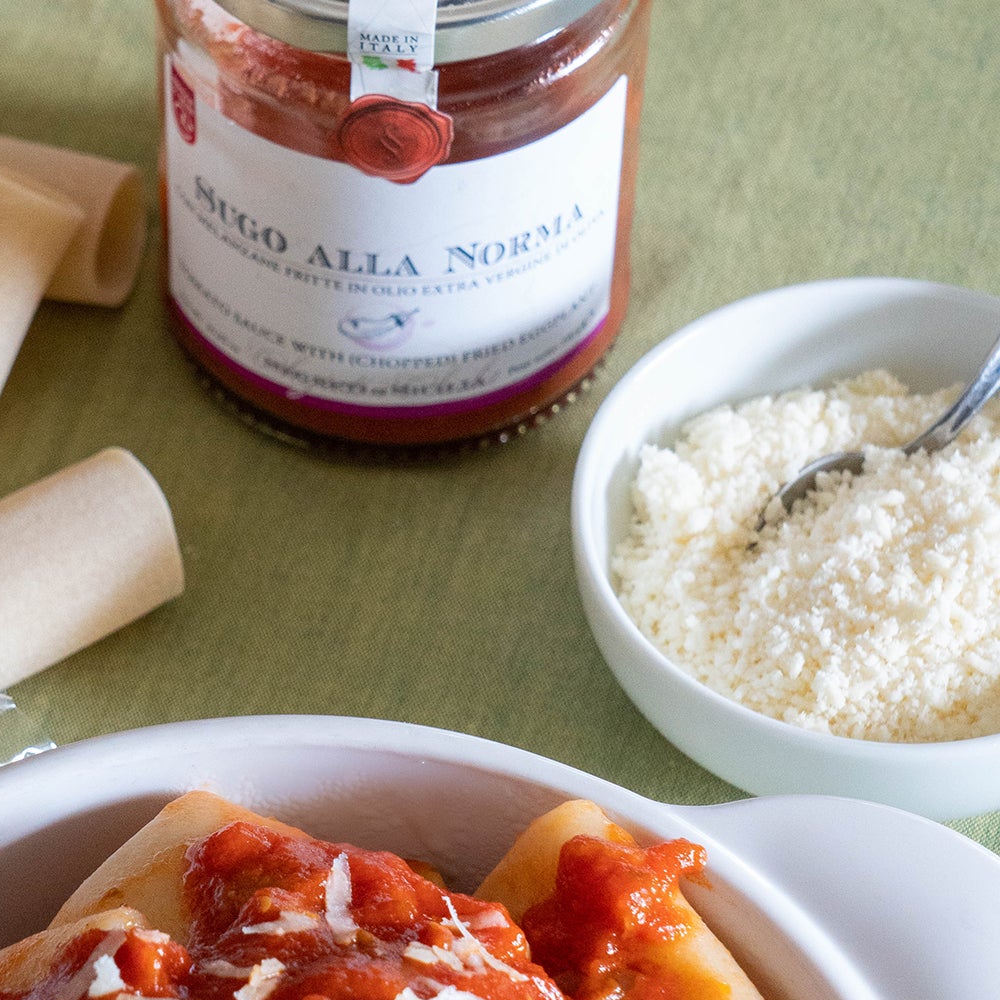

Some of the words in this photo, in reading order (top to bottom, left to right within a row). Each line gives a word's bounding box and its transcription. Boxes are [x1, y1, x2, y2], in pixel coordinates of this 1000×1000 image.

[360, 33, 397, 42] MADE
[404, 35, 419, 43] IN
[360, 42, 419, 53] ITALY
[307, 243, 419, 276] ALLA
[445, 203, 584, 275] NORMA
[347, 282, 368, 297] IN
[371, 283, 418, 298] OLIO
[422, 280, 480, 297] EXTRA
[291, 340, 345, 362] WITH
